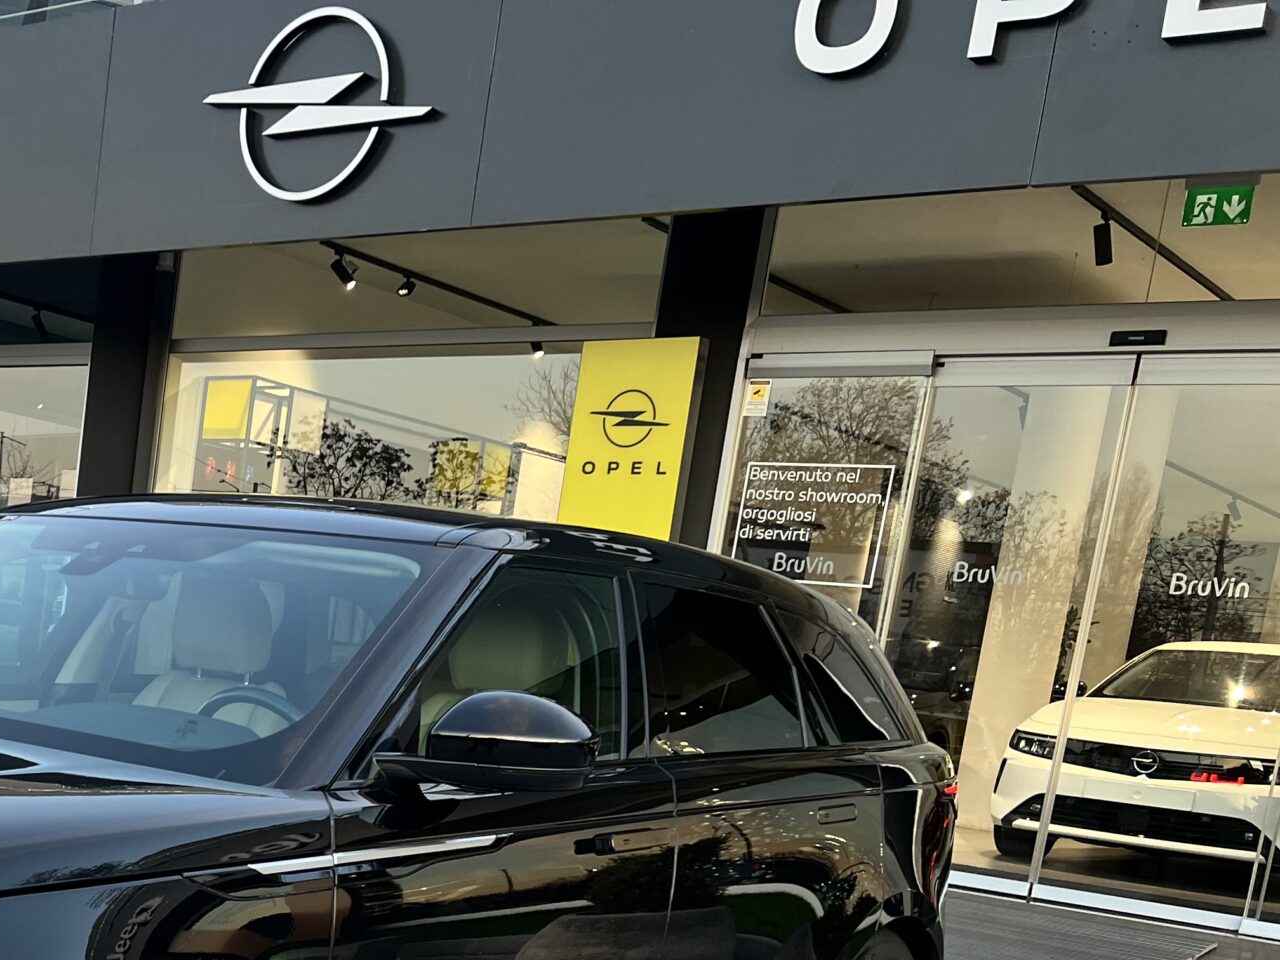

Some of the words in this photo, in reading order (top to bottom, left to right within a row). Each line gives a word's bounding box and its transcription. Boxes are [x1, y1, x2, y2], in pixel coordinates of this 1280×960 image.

[581, 461, 667, 475] OPEL
[749, 466, 832, 482] Benvenuto
[836, 468, 860, 483] nel
[746, 487, 795, 501] nostro
[798, 487, 886, 507] showroom,
[742, 507, 817, 524] orgogliosi
[739, 525, 753, 539] di
[755, 527, 811, 542] servirti
[772, 552, 835, 576] BruVin
[952, 561, 1024, 585] BruVin
[1168, 572, 1251, 599] BruVin
